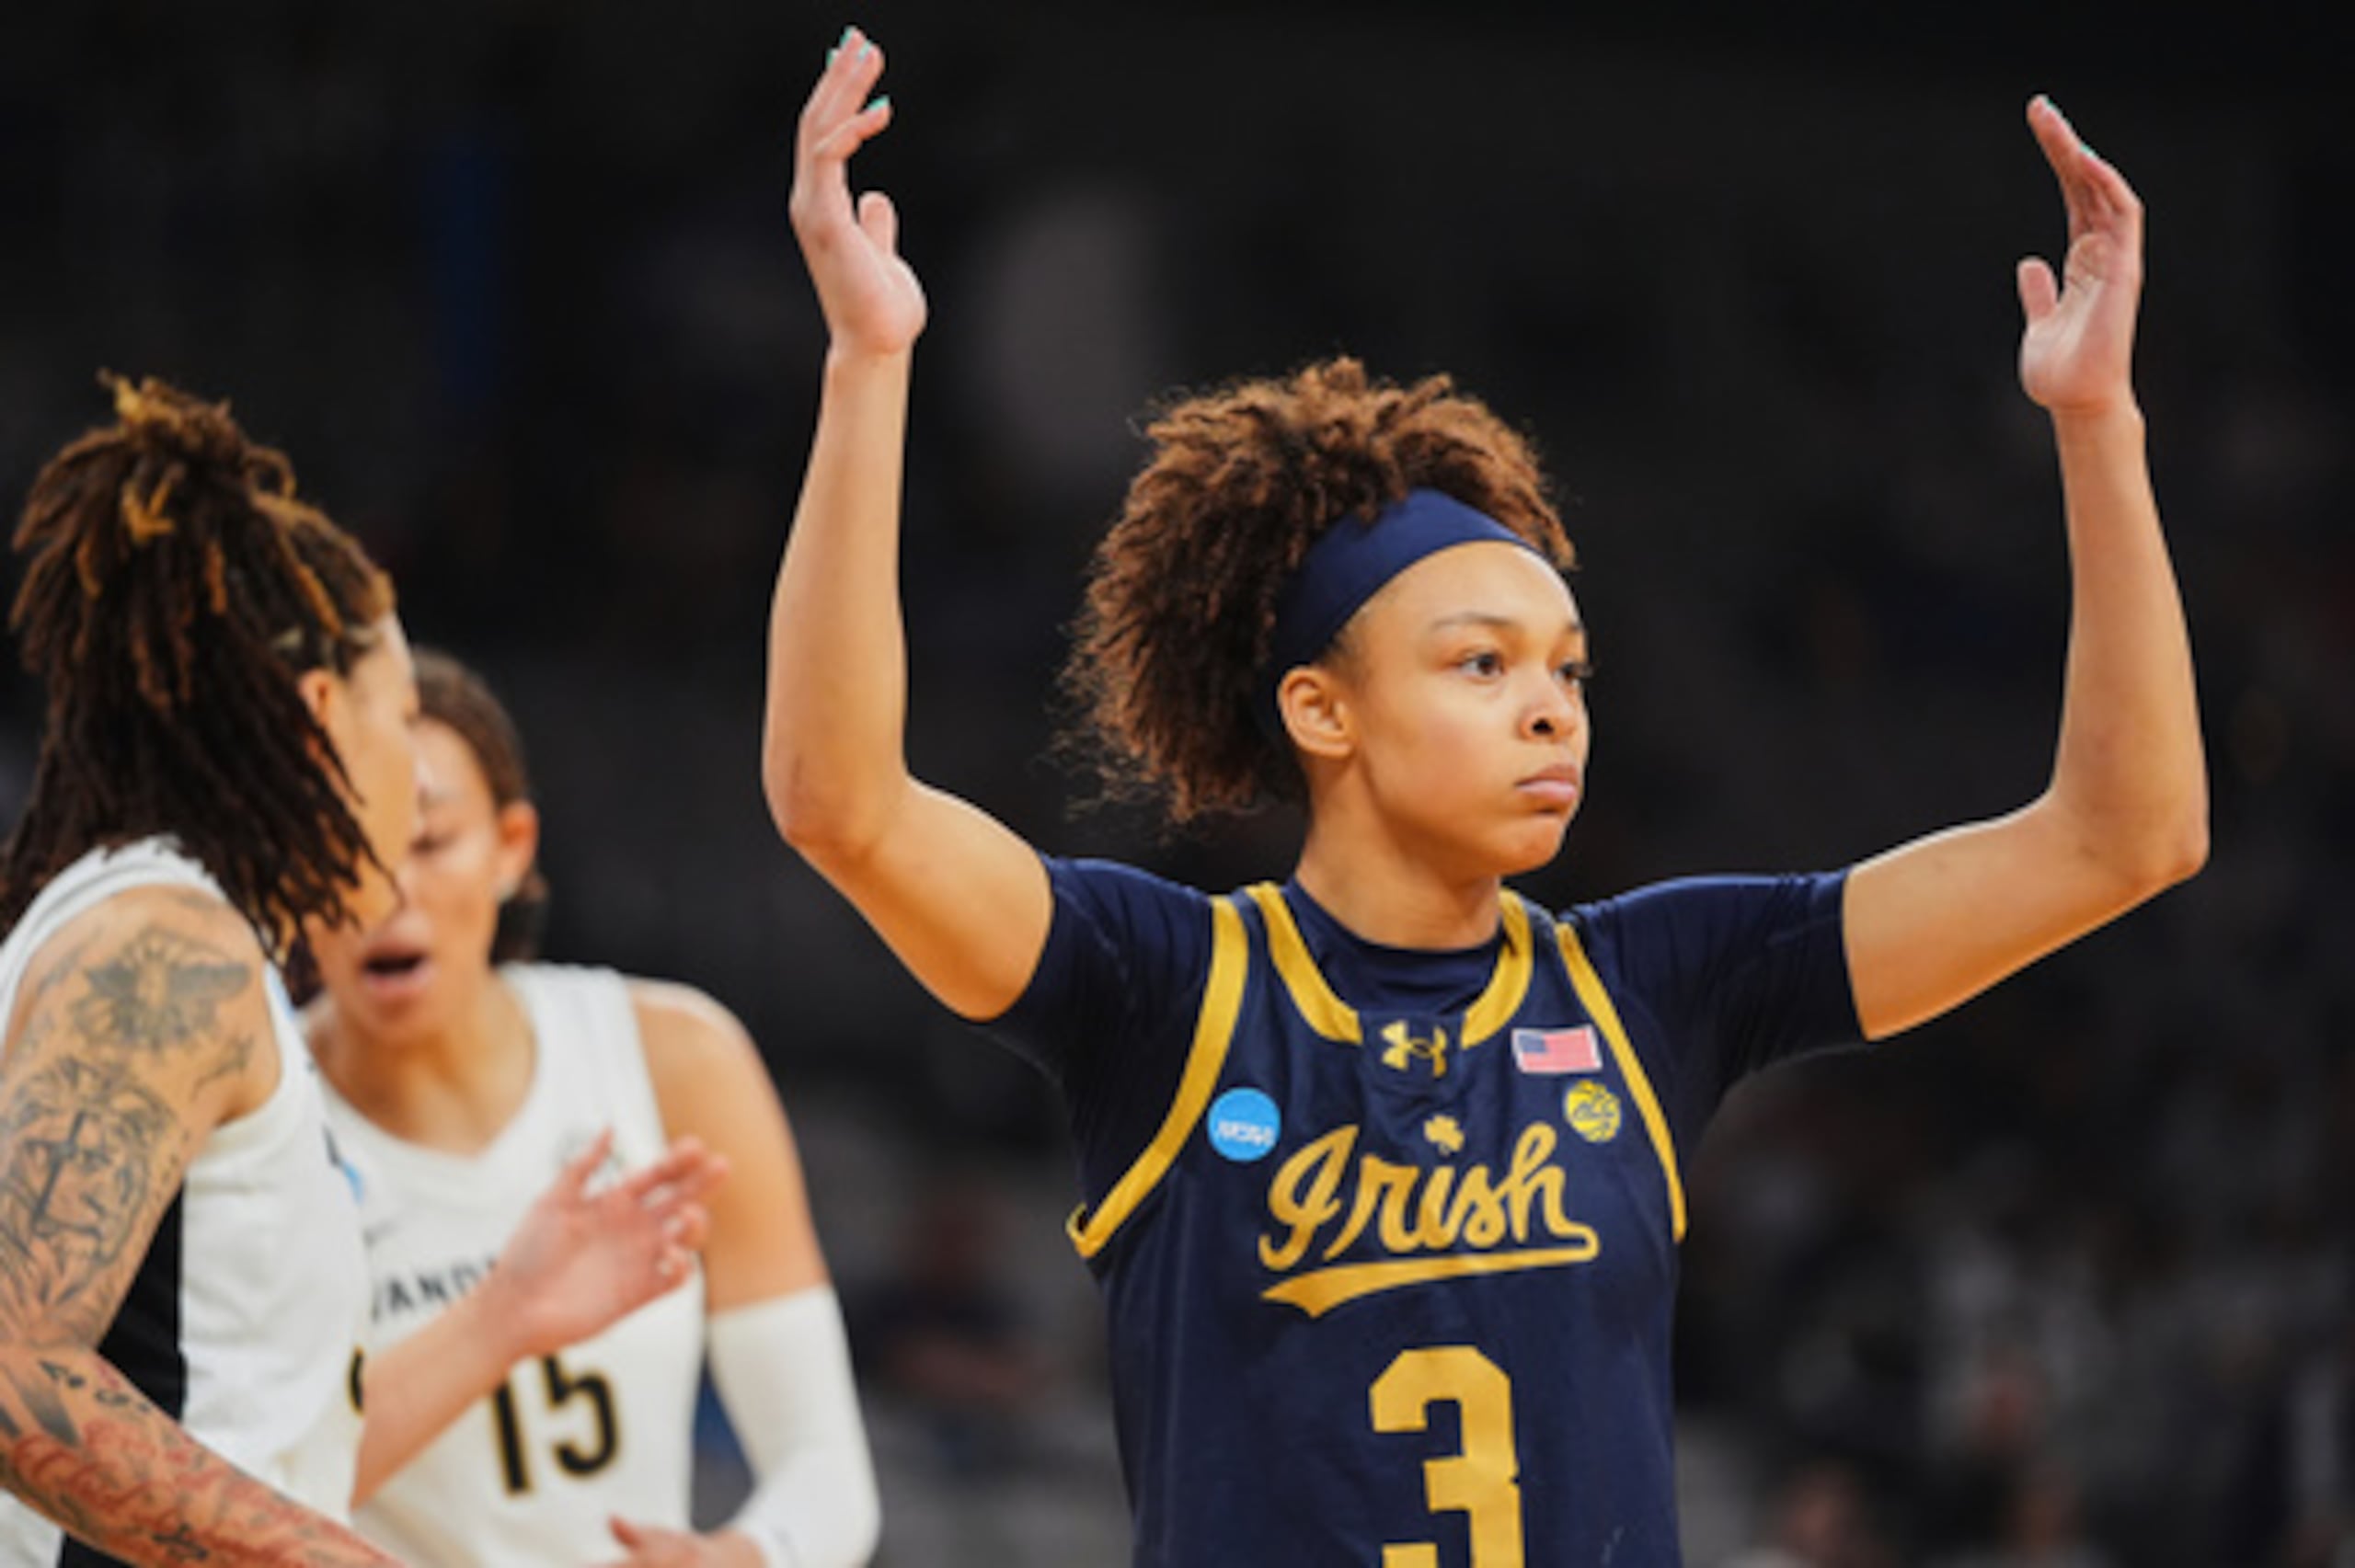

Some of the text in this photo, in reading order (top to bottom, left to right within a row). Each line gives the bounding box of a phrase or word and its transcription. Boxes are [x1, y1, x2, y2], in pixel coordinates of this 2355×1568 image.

[1258, 1122, 1599, 1288] Irish
[492, 1353, 620, 1497] 15
[1369, 1345, 1525, 1568] 3
